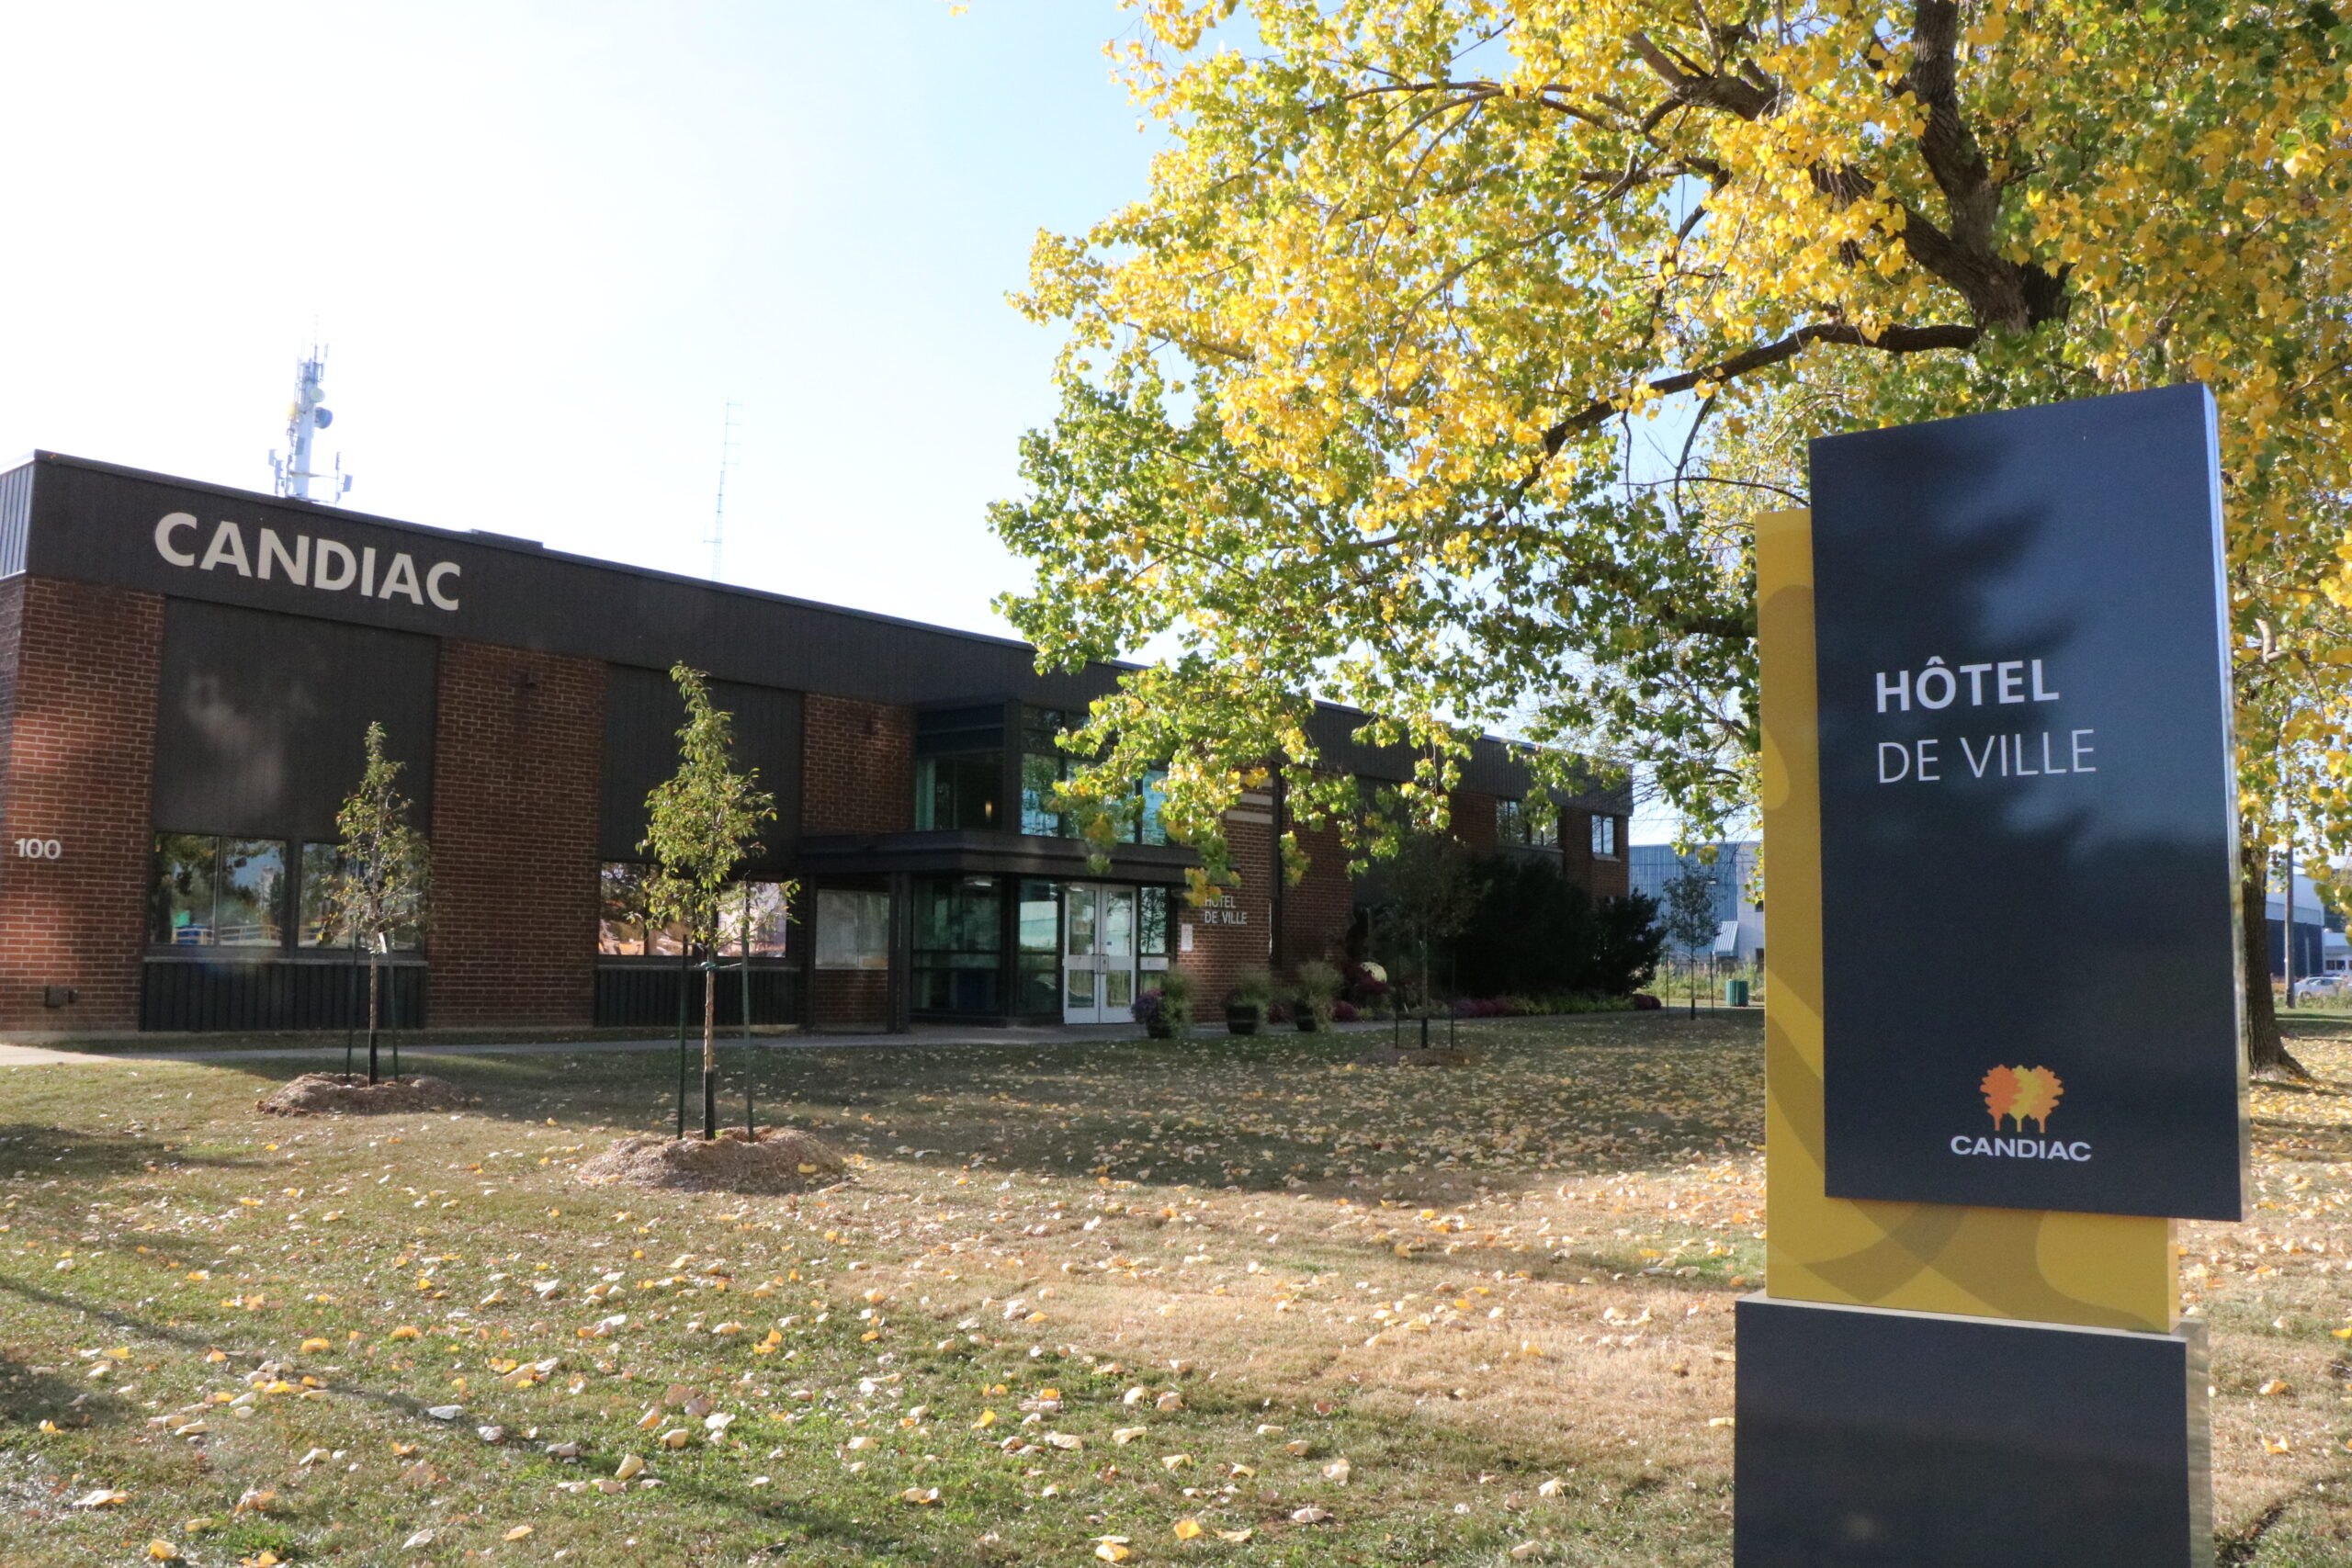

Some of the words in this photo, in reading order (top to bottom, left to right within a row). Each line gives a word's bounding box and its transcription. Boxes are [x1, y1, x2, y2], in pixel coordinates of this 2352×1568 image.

[154, 511, 461, 611] CANDIAC
[1875, 654, 2060, 714] HÔTEL
[1877, 739, 1940, 784] DE
[1960, 728, 2098, 778] VILLE
[15, 838, 62, 860] 100
[1204, 910, 1218, 924] DE
[1222, 911, 1248, 925] VILLE
[1950, 1134, 2093, 1163] CANDIAC
